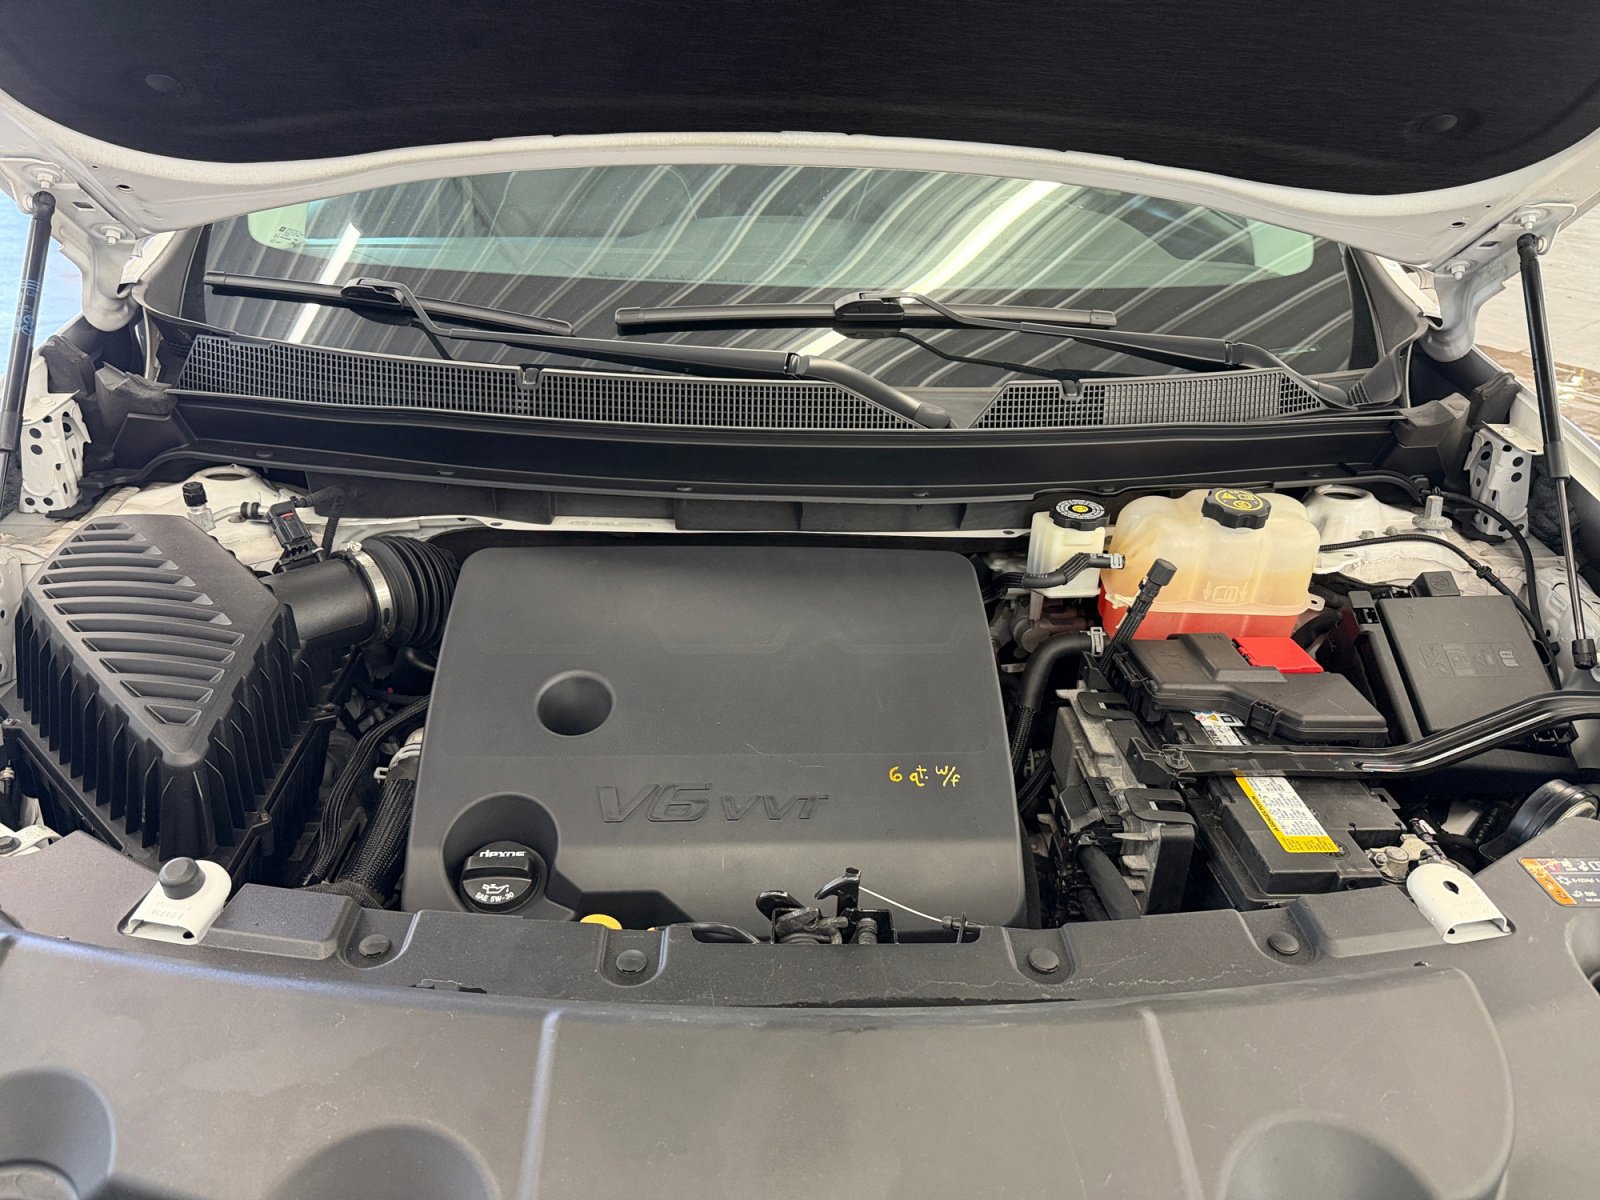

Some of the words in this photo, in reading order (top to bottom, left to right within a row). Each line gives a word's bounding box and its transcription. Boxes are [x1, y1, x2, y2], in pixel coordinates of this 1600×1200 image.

[889, 766, 903, 782] 6
[596, 783, 713, 823] V6
[720, 794, 829, 821] VVT
[475, 892, 489, 902] SAE
[490, 892, 514, 902] 5W-30
